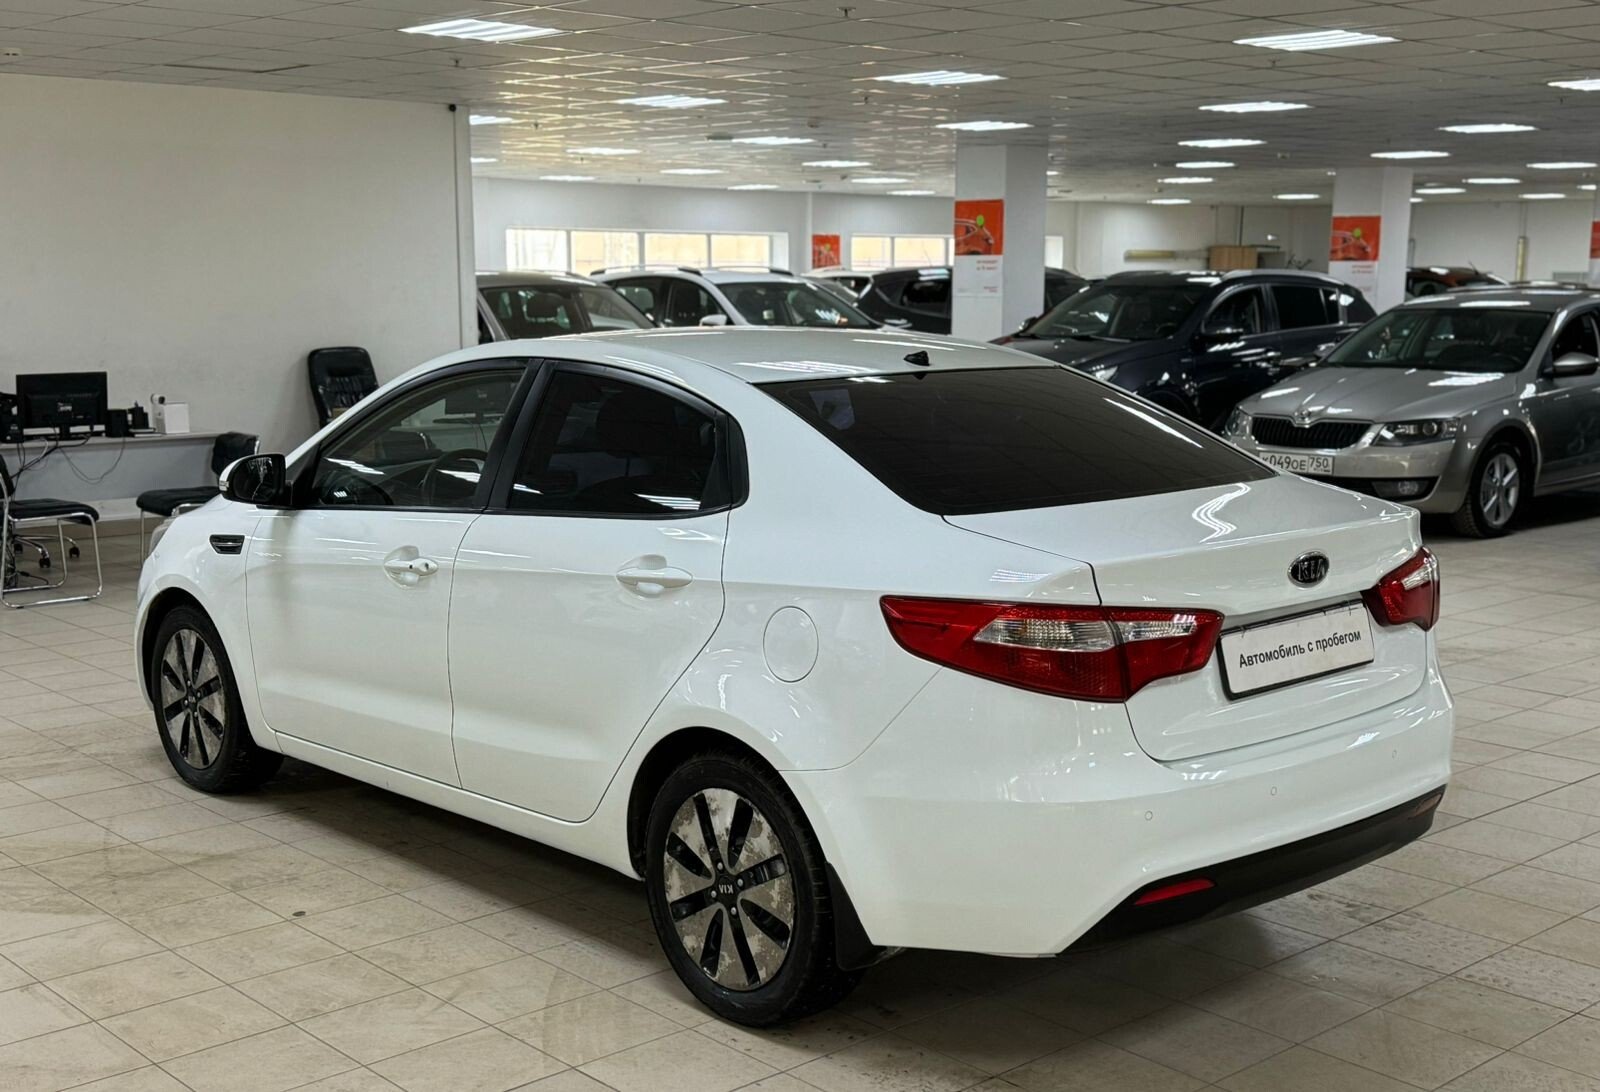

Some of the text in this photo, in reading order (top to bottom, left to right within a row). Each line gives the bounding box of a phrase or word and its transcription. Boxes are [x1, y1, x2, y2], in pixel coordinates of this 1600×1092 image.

[1309, 456, 1328, 469] 750
[1298, 558, 1326, 581] KIA
[1239, 630, 1362, 668] Автомобиль с пробегом
